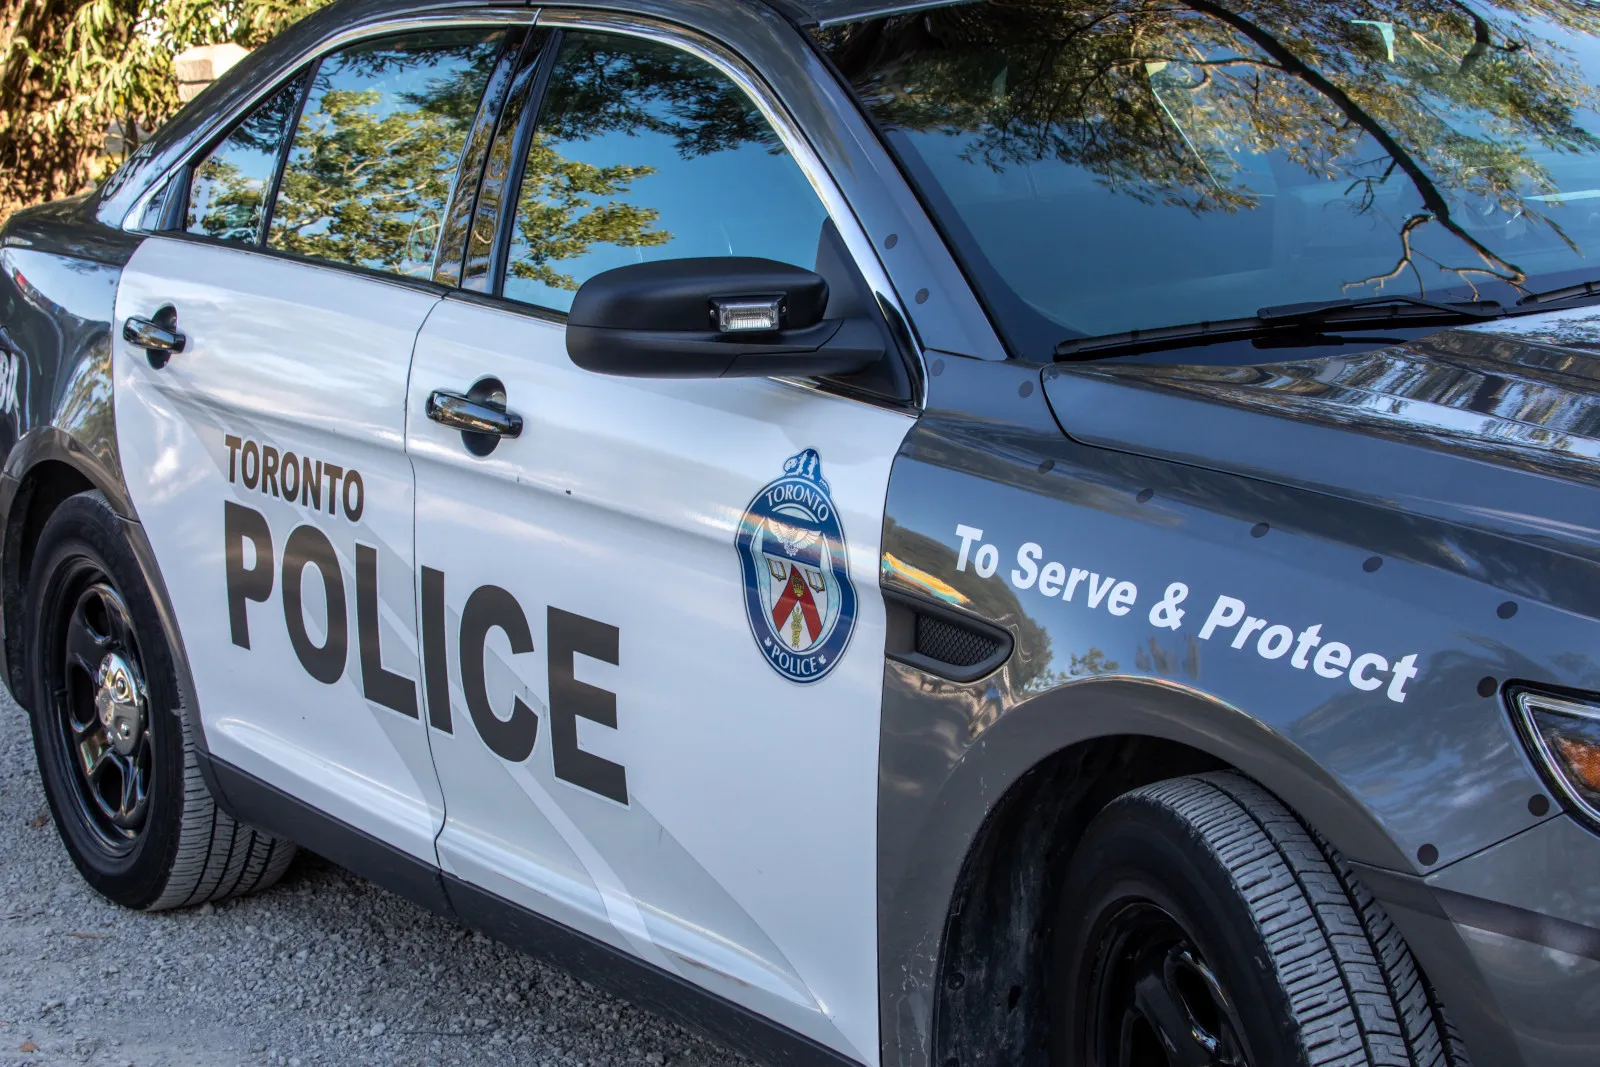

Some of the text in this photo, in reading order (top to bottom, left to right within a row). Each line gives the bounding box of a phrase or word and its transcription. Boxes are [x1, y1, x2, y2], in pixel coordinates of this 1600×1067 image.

[224, 434, 365, 522] TORONTO
[766, 484, 830, 522] TORONTO
[224, 500, 630, 806] POLICE
[954, 523, 1418, 703] To Serve & Protect
[771, 644, 819, 676] POLICE
